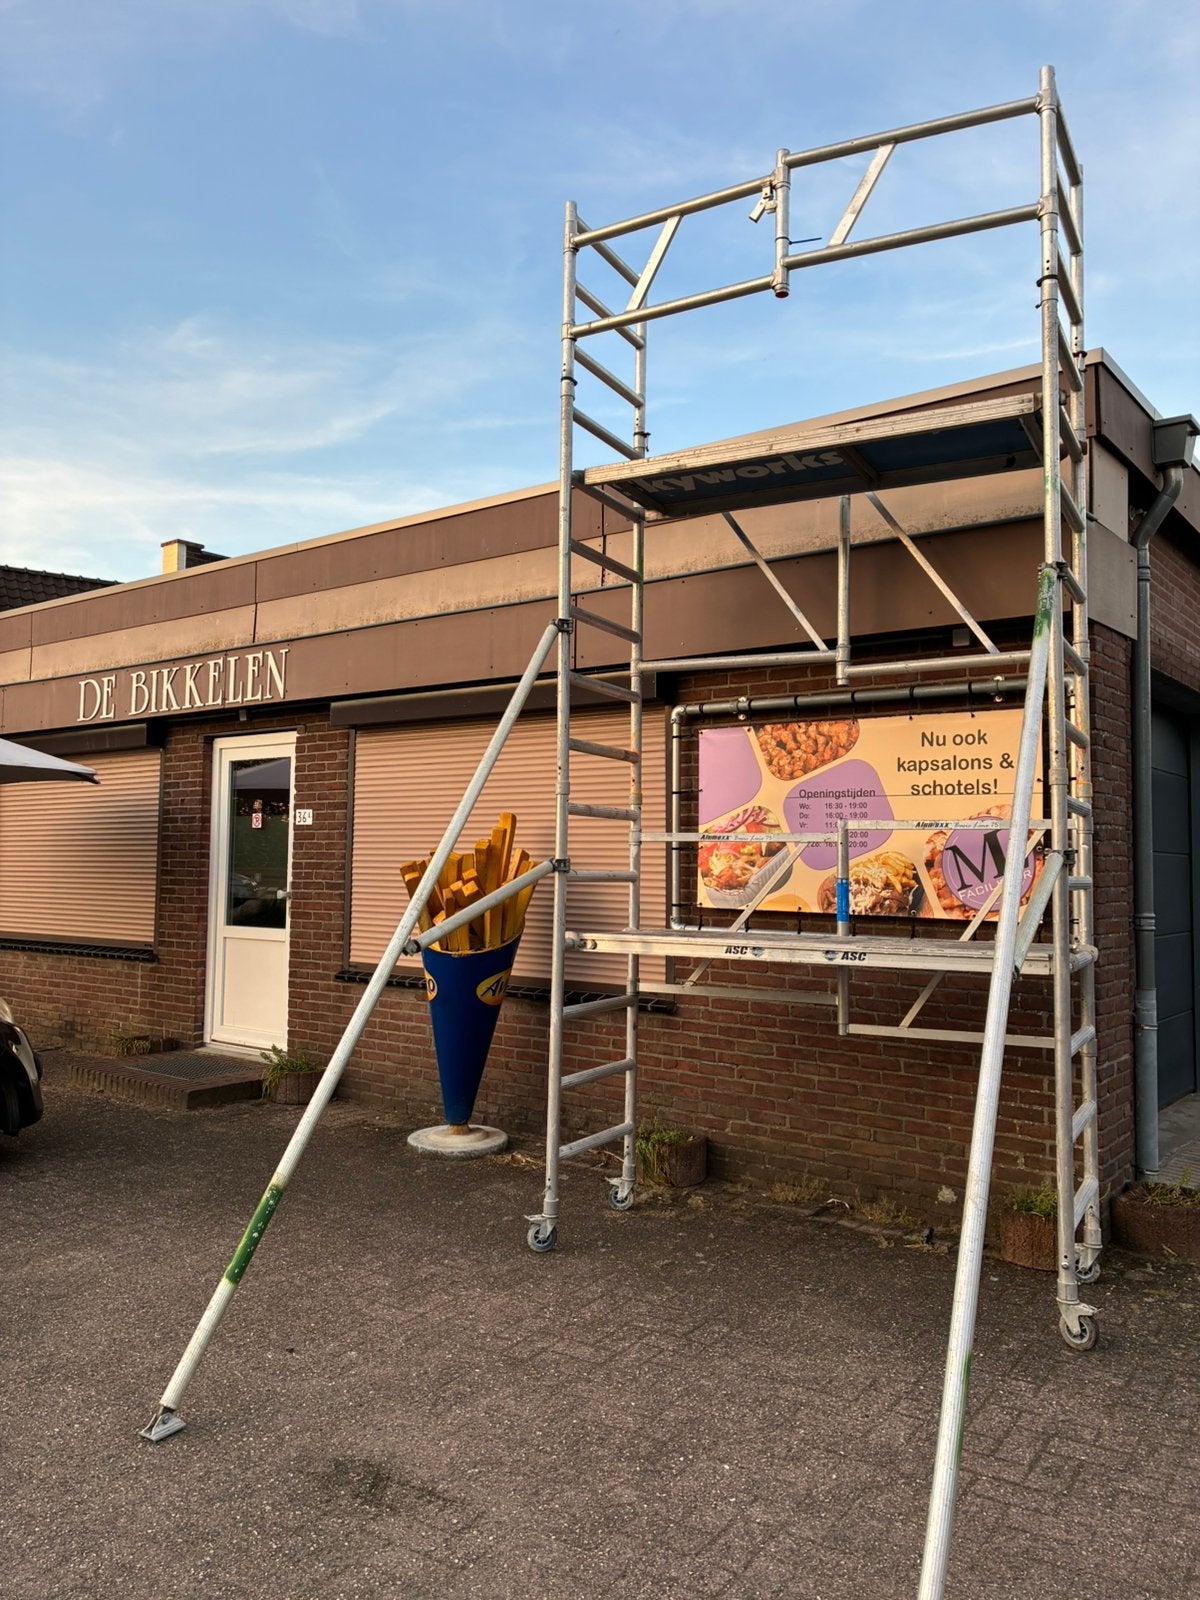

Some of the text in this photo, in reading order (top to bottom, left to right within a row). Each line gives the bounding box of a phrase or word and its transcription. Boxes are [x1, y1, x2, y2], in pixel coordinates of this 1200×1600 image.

[77, 649, 289, 722] DE BIKKELEN
[921, 729, 988, 747] Nu ook
[897, 753, 1014, 775] kapsalons &
[799, 788, 876, 800] Openingstijden
[911, 778, 998, 796] schotels!
[725, 945, 748, 955] ASC
[841, 952, 867, 961] ASC
